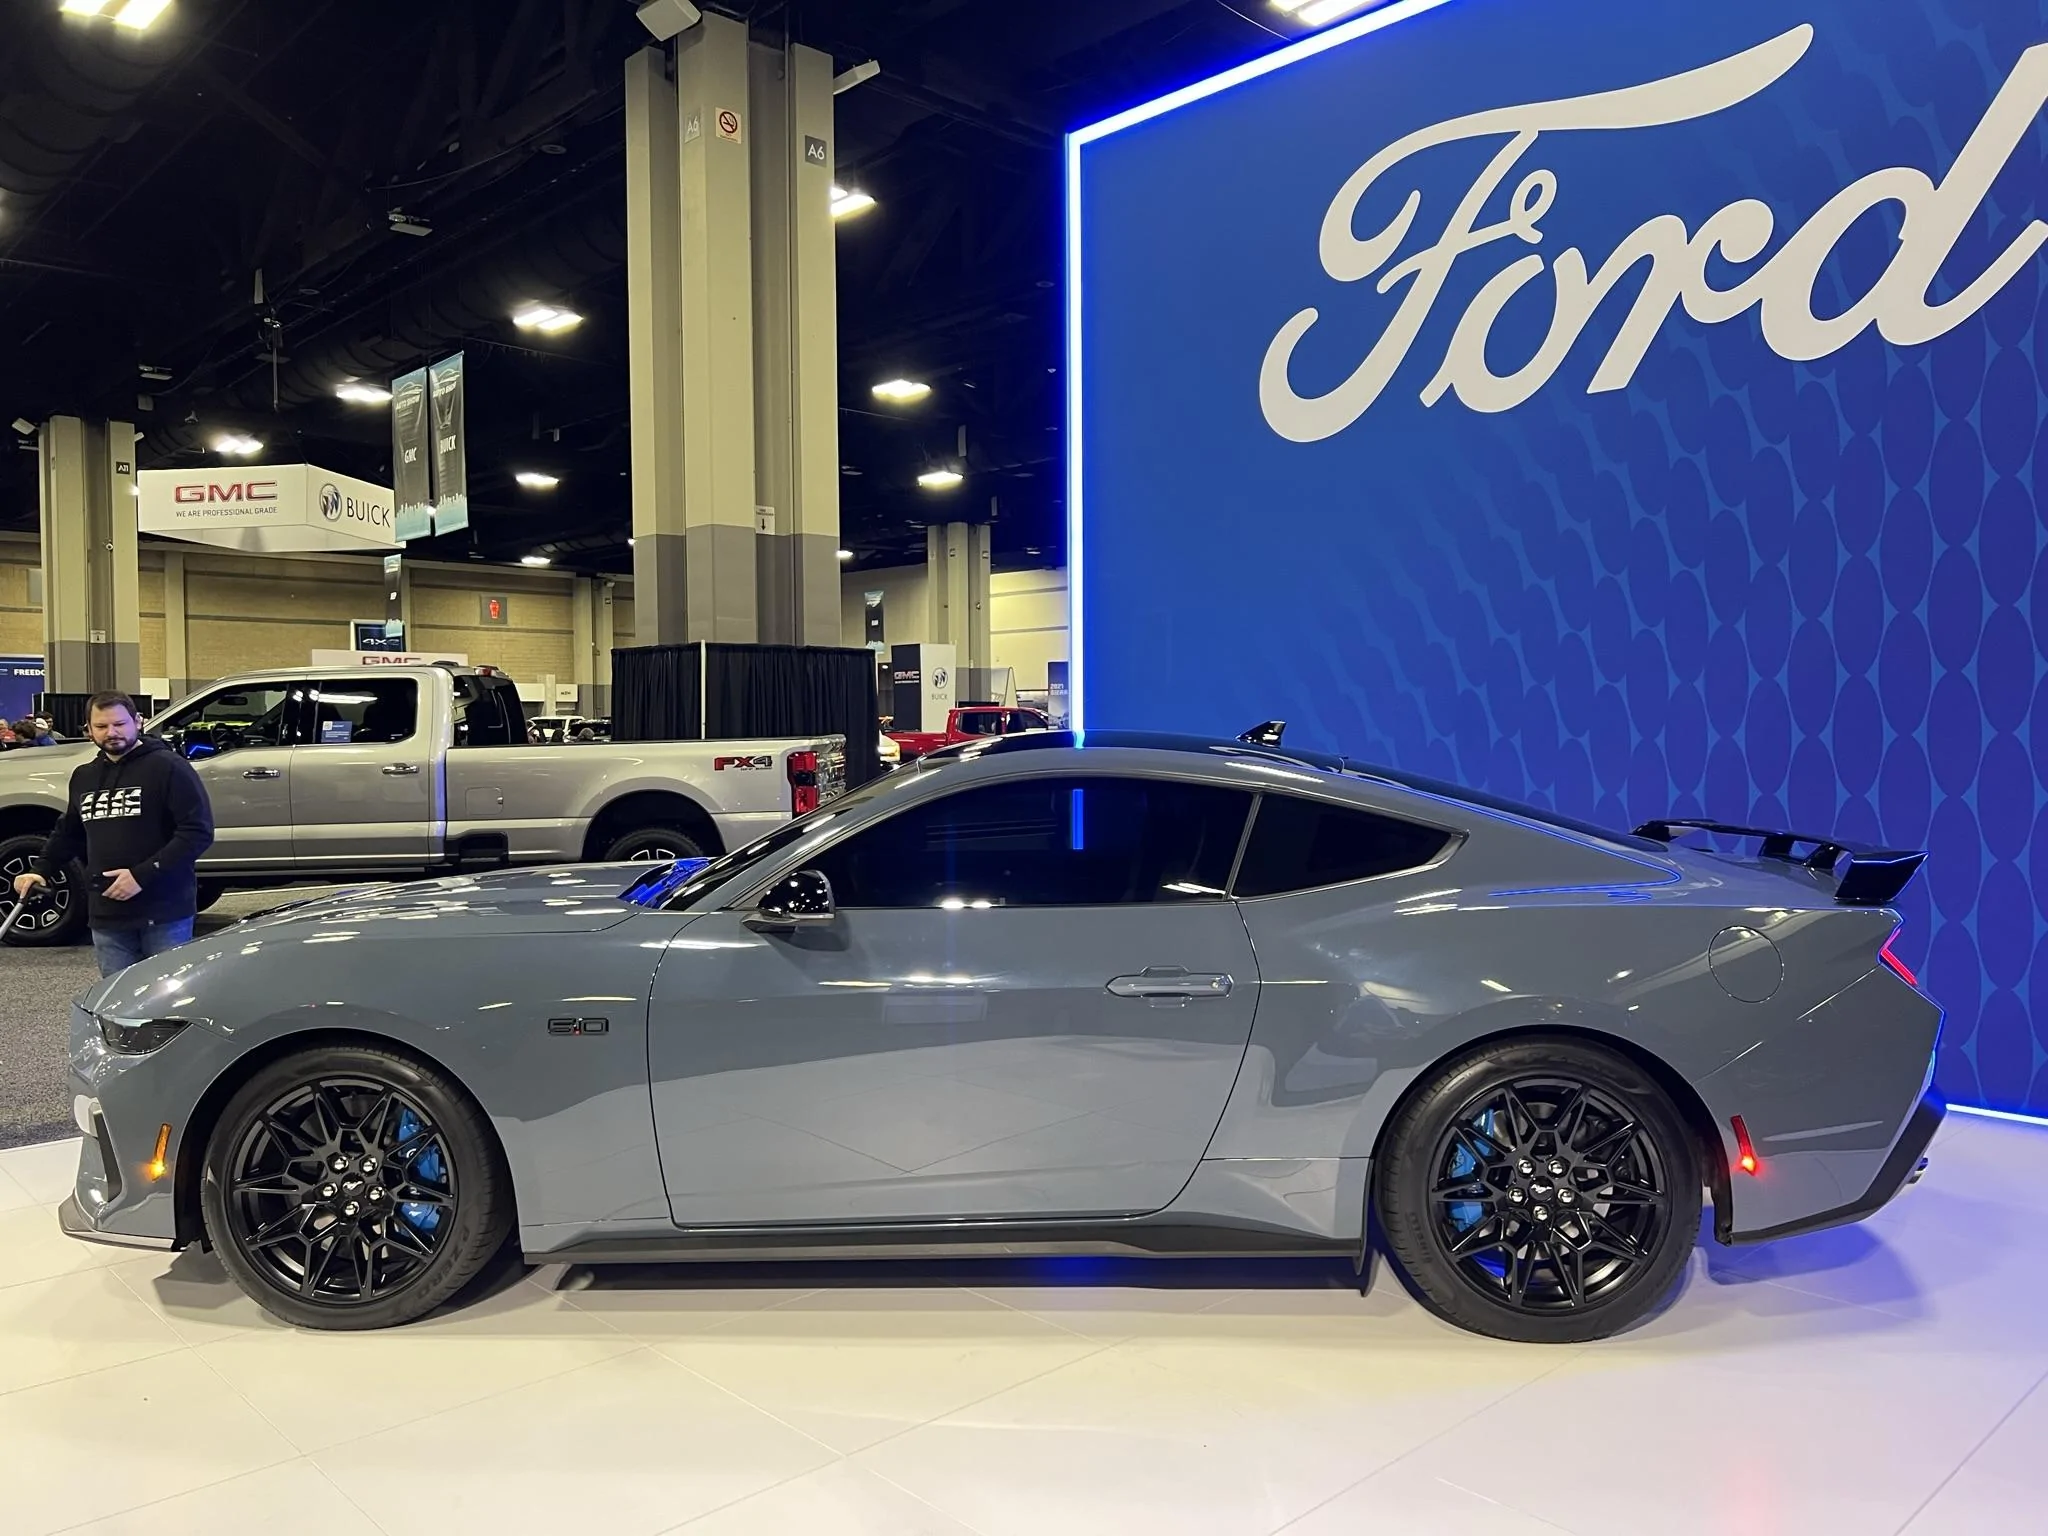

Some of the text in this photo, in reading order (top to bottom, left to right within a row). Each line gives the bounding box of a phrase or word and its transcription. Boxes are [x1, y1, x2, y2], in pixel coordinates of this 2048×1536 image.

[687, 116, 700, 133] A6
[807, 143, 825, 160] A6
[1259, 23, 2048, 443] Ford
[440, 434, 457, 454] BUICK
[404, 446, 417, 463] GMC
[174, 480, 278, 504] GMC
[176, 507, 277, 518] WE ARE PROFESSIONAL GRADE
[346, 497, 391, 528] BUICK
[894, 670, 920, 680] GMC
[714, 755, 773, 771] FX4
[547, 1017, 609, 1036] 5.0
